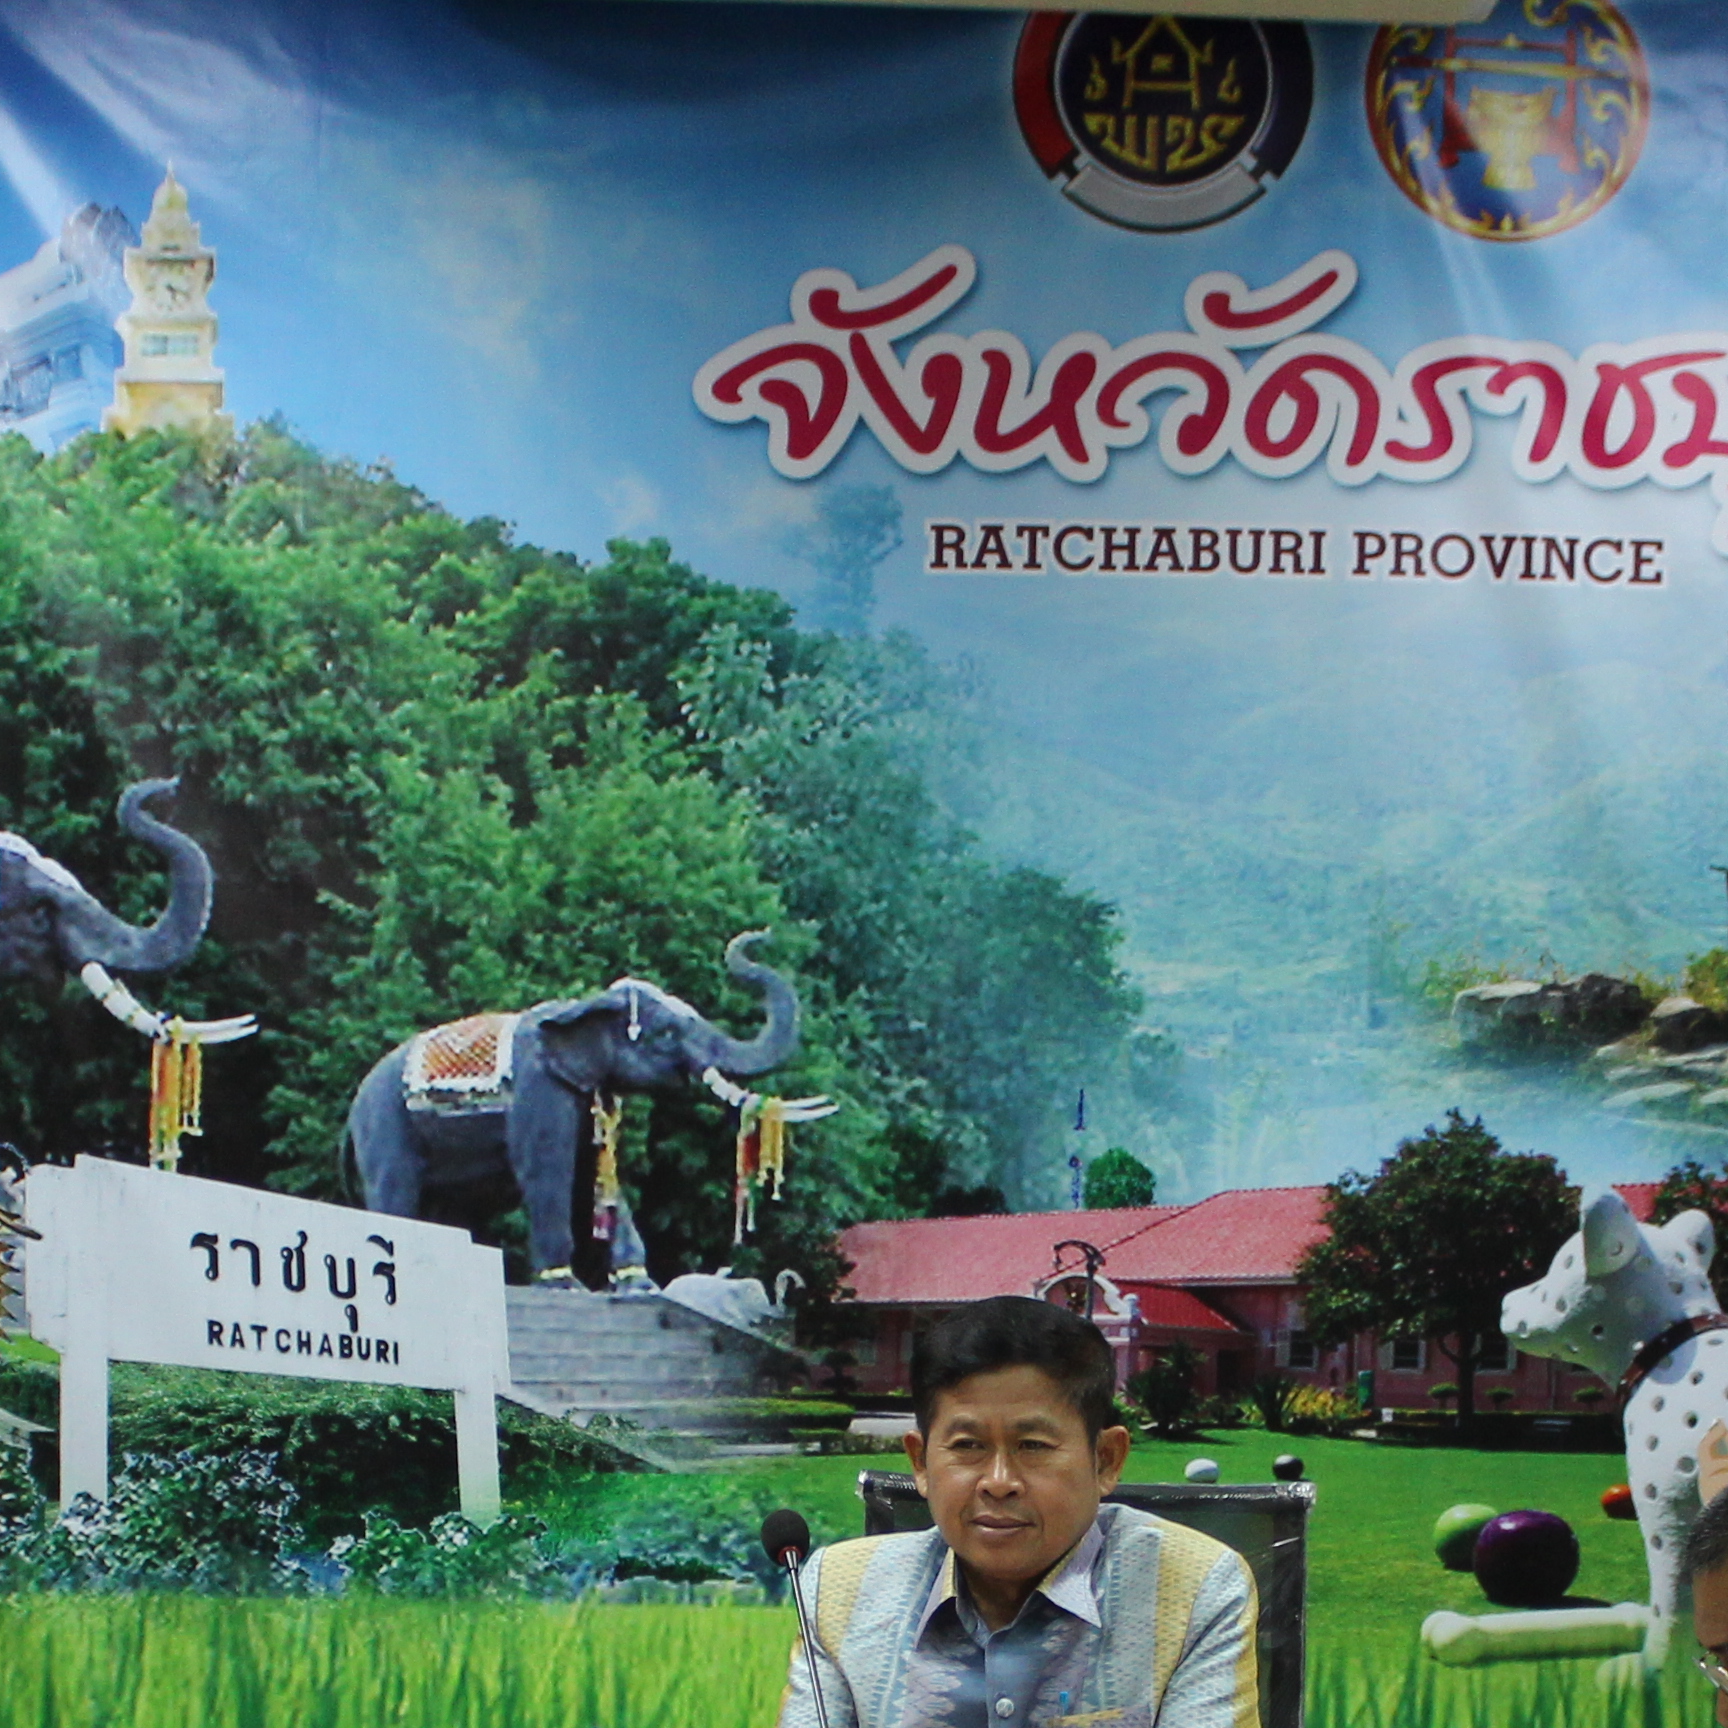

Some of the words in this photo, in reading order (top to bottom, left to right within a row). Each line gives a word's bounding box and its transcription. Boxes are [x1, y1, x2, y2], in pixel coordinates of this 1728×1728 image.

[929, 524, 1327, 576] RATCHABURI
[1352, 531, 1664, 584] PROVINCE
[190, 1230, 397, 1333] ราชบุรี
[207, 1319, 400, 1366] RATCHABURI
